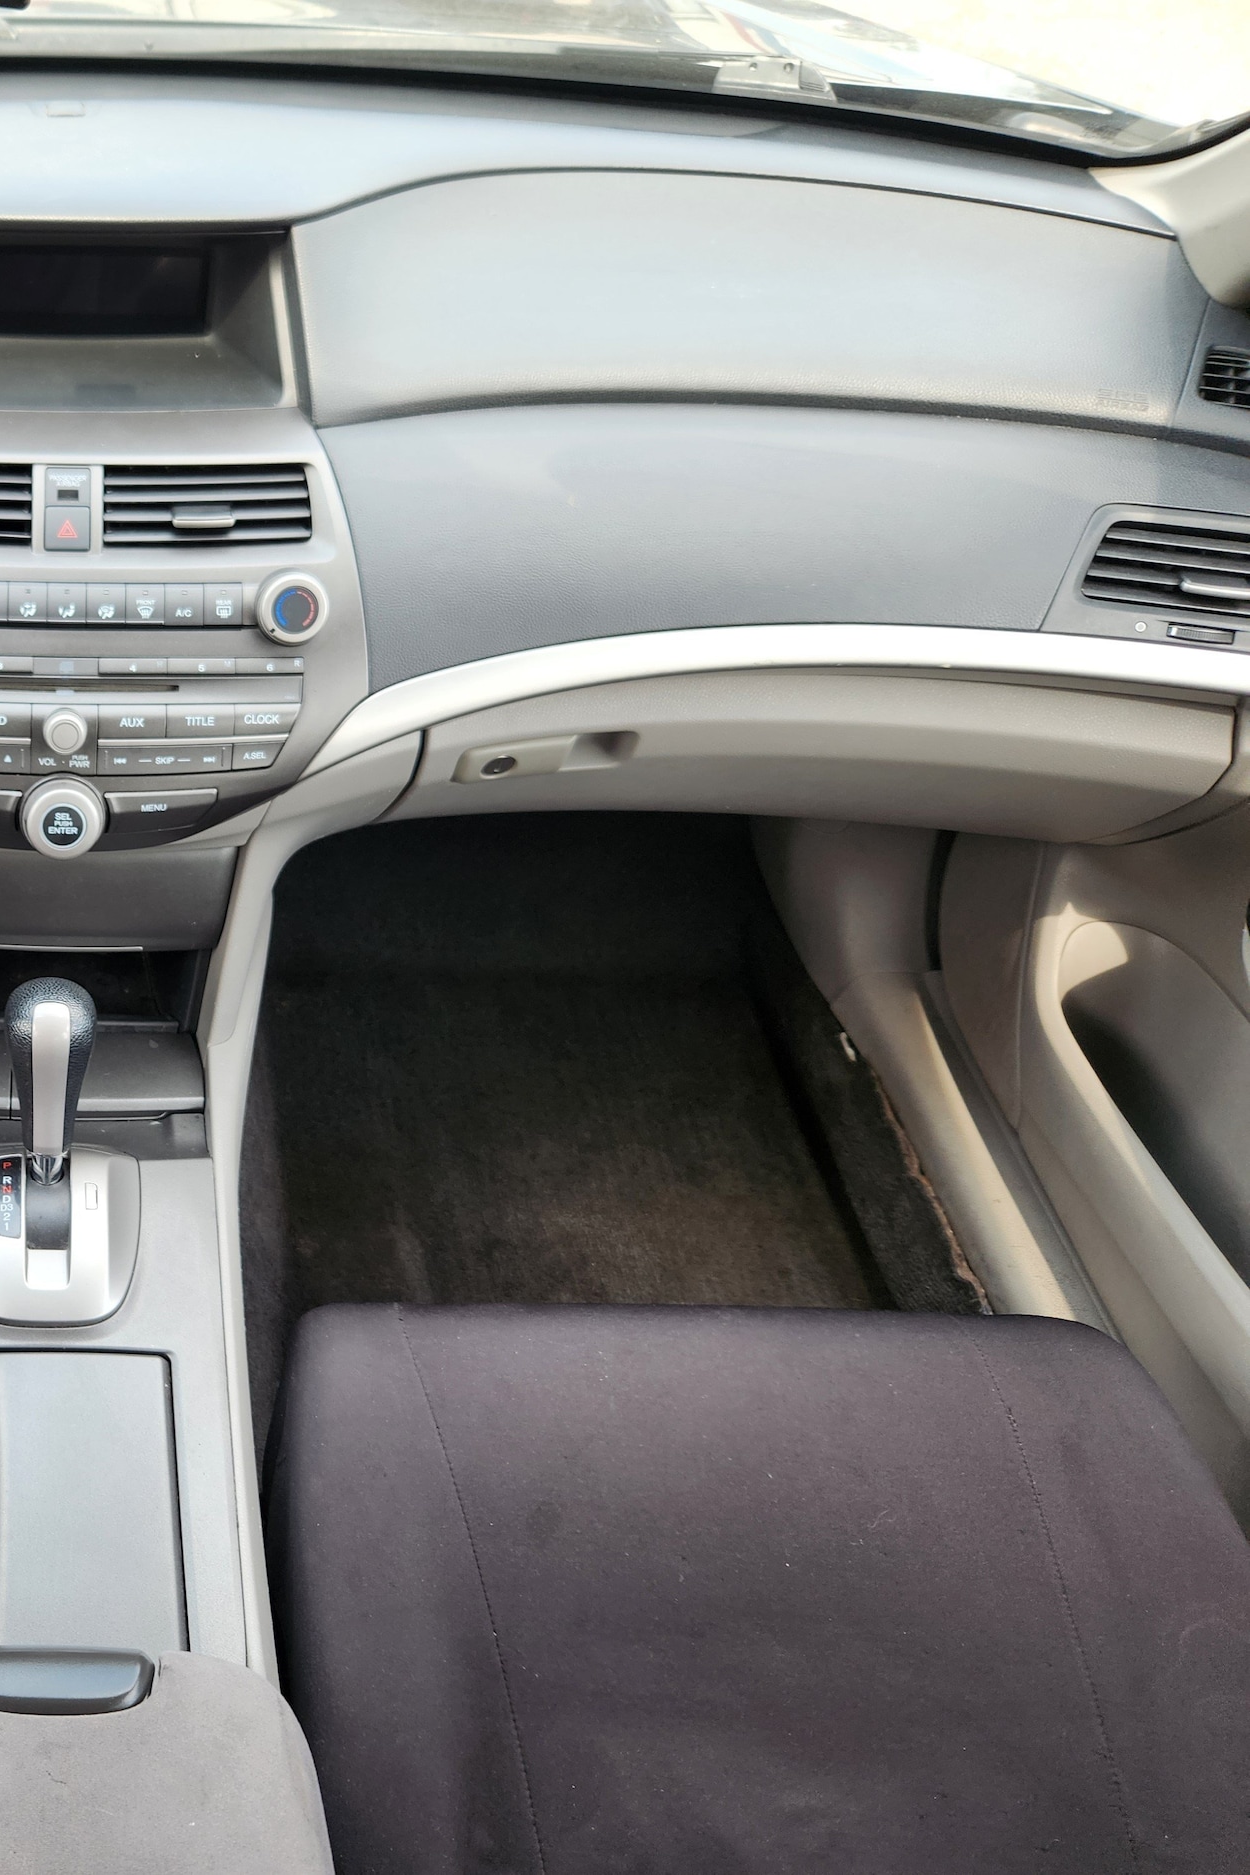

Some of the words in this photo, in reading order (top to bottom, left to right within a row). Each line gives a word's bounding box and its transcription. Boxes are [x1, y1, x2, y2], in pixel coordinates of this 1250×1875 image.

[175, 608, 192, 618] A/C
[294, 659, 300, 667] R
[129, 664, 137, 672] 4
[197, 664, 205, 672] 5
[266, 664, 274, 672] 6
[119, 717, 144, 728] AUX
[185, 716, 215, 727] TITLE
[244, 714, 280, 725] CLOCK
[155, 756, 174, 765] SKIP
[243, 752, 267, 760] A.SEL
[38, 758, 57, 767] VOL
[69, 760, 90, 768] PWR
[141, 803, 167, 812] MENU
[54, 812, 72, 821] SEL
[48, 826, 78, 835] ENTER
[3, 1161, 12, 1169] P
[3, 1176, 12, 1184] R
[2, 1186, 12, 1194] N
[2, 1195, 11, 1204] D
[0, 1203, 13, 1212] D3
[3, 1212, 10, 1221] 2
